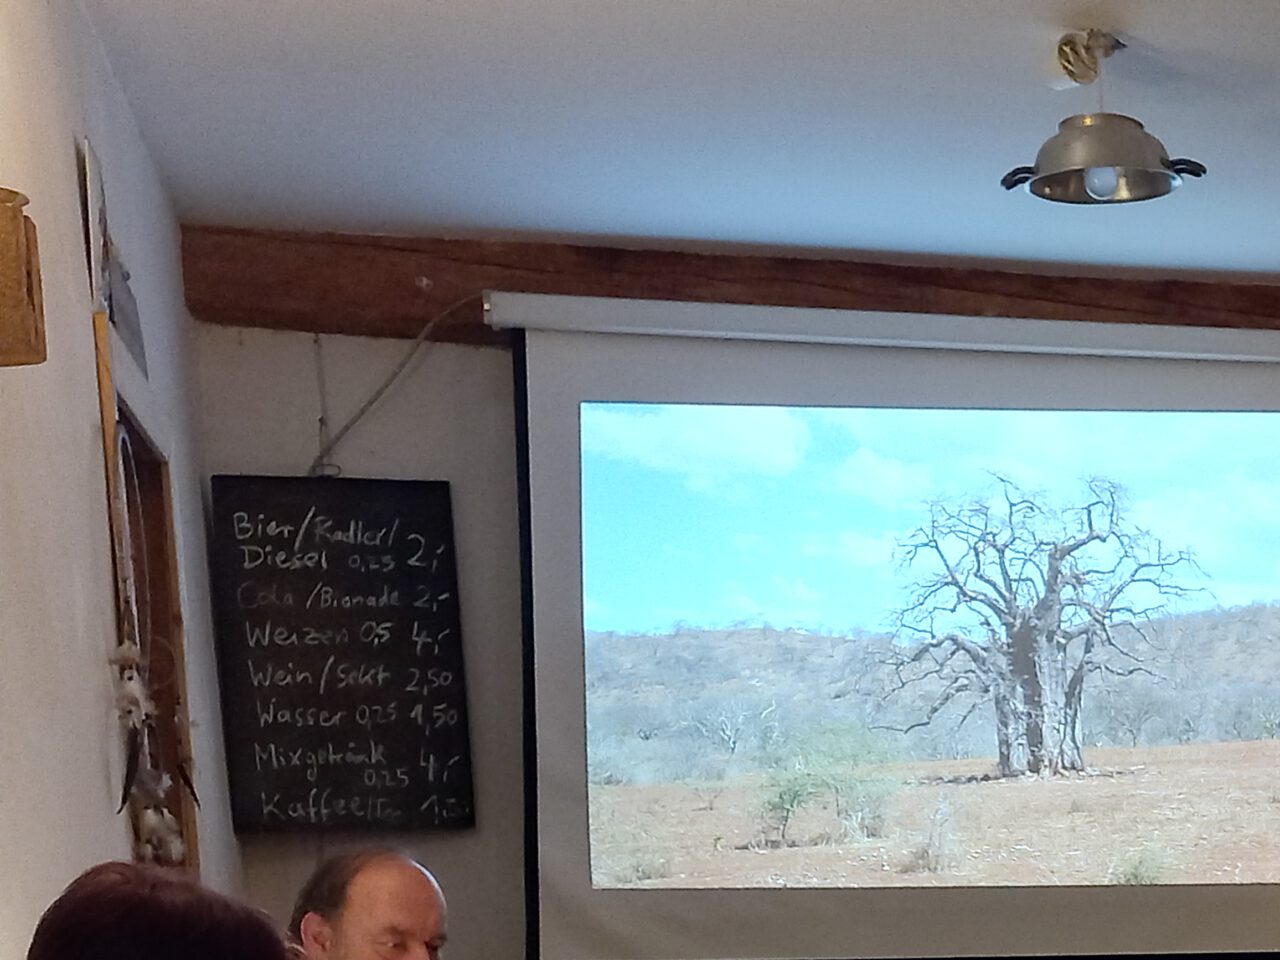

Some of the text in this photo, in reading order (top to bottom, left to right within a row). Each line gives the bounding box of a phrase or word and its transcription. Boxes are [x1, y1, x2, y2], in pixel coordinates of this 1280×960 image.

[242, 545, 329, 570] Diesel
[405, 667, 453, 696] 2,50
[256, 697, 343, 728] Wasser
[410, 703, 459, 736] 1,50
[364, 767, 410, 788] 0,25
